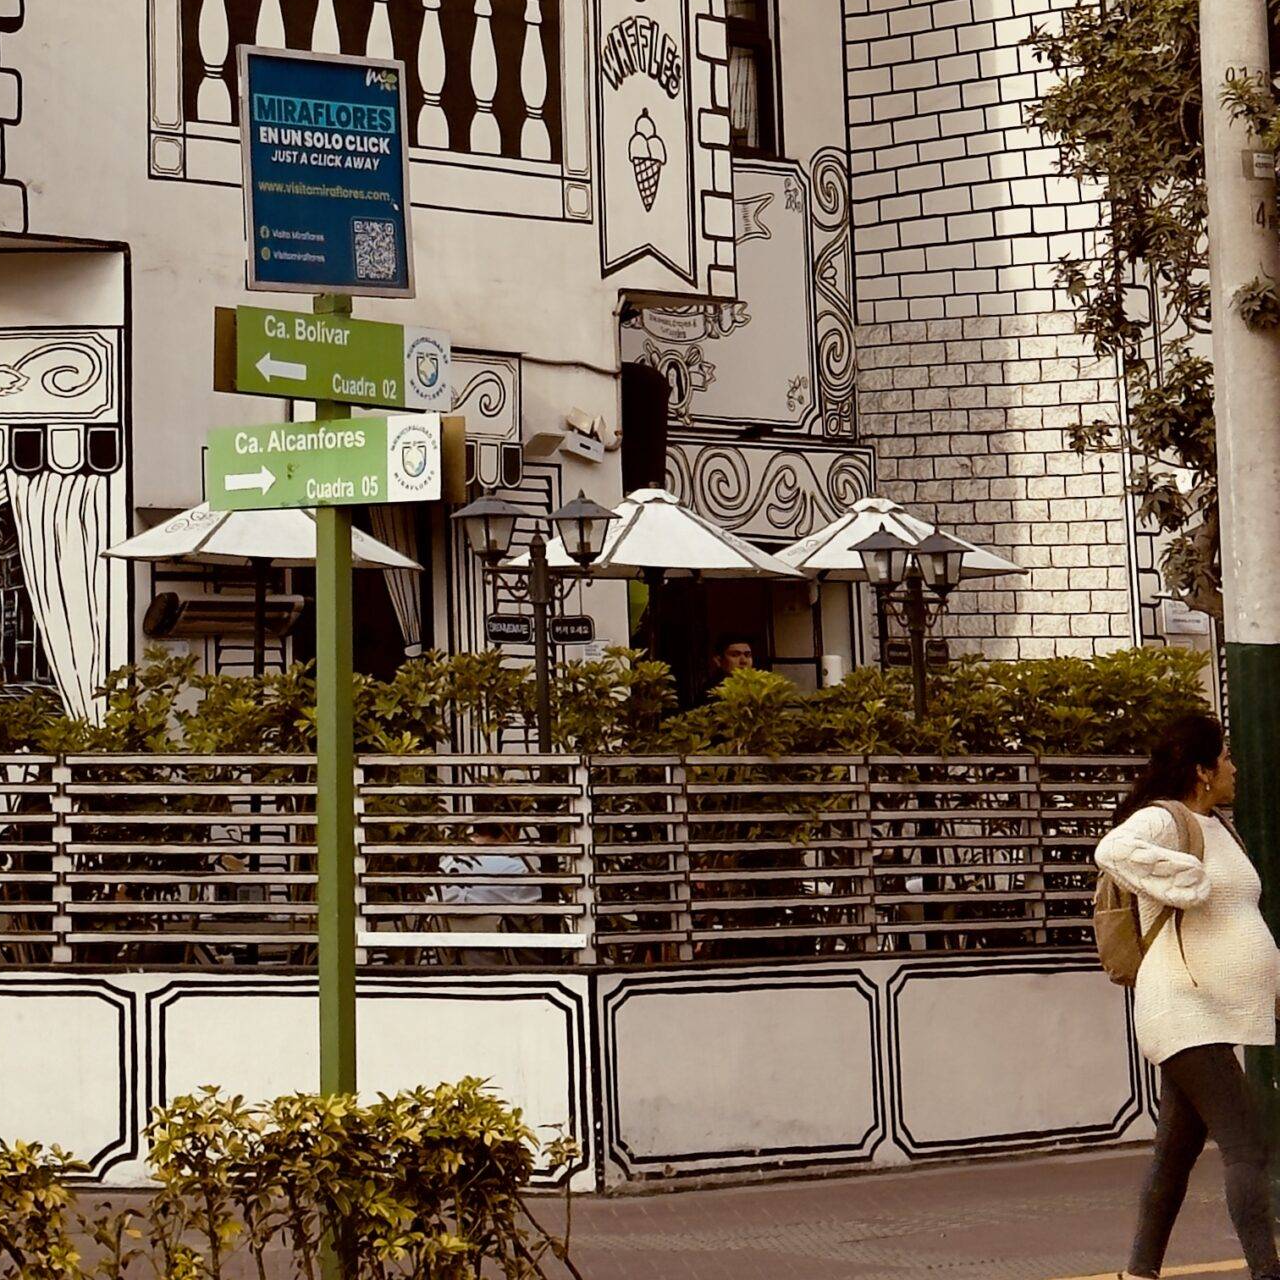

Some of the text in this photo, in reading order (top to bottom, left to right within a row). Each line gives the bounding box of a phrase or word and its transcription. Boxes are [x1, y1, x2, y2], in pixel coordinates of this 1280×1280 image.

[601, 15, 682, 99] WAFFLES
[256, 97, 392, 131] MIRAFLORES
[259, 125, 391, 155] EN UN SOLO CLICK
[271, 149, 381, 171] JUST A CLICK AWAY
[263, 314, 351, 346] Ca. Bolívar
[332, 373, 397, 400] Cuadra 02
[234, 427, 365, 455] Ca. Alcanfores
[306, 476, 378, 499] Cuadra 05
